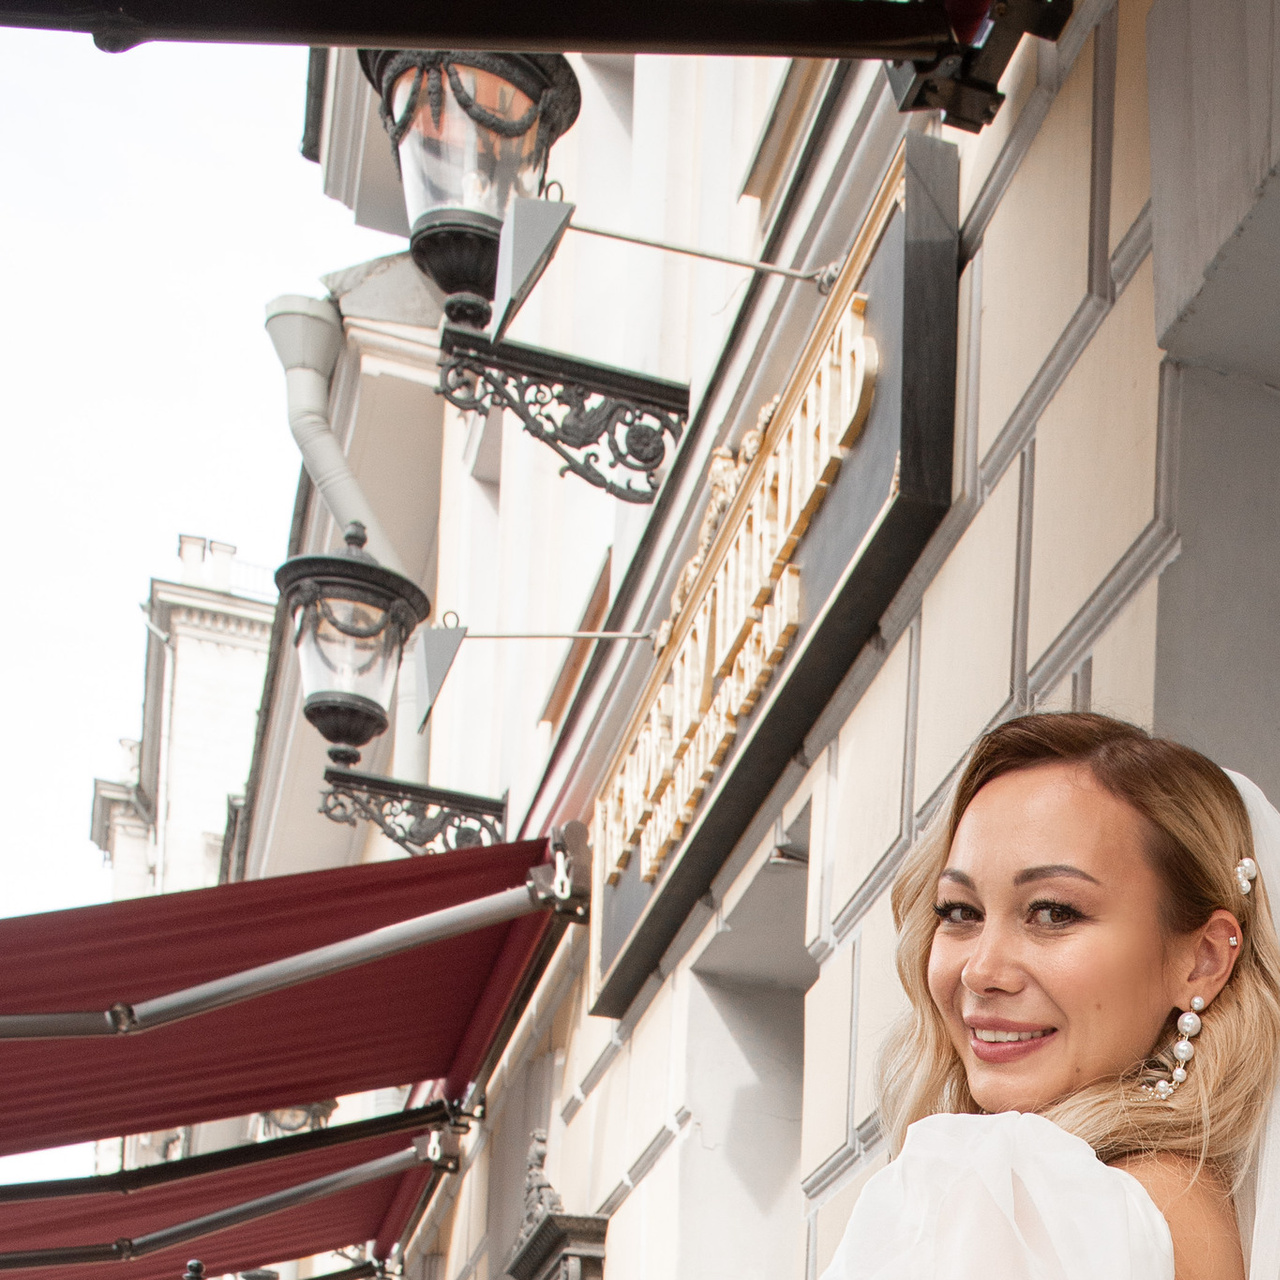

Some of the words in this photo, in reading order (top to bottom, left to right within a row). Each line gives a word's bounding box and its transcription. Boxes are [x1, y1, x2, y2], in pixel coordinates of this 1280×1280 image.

[603, 684, 674, 885] КАФЕ
[671, 292, 879, 760] ПУШКИНЪ
[639, 564, 801, 880] КОНДИТЕРСКАЯ
